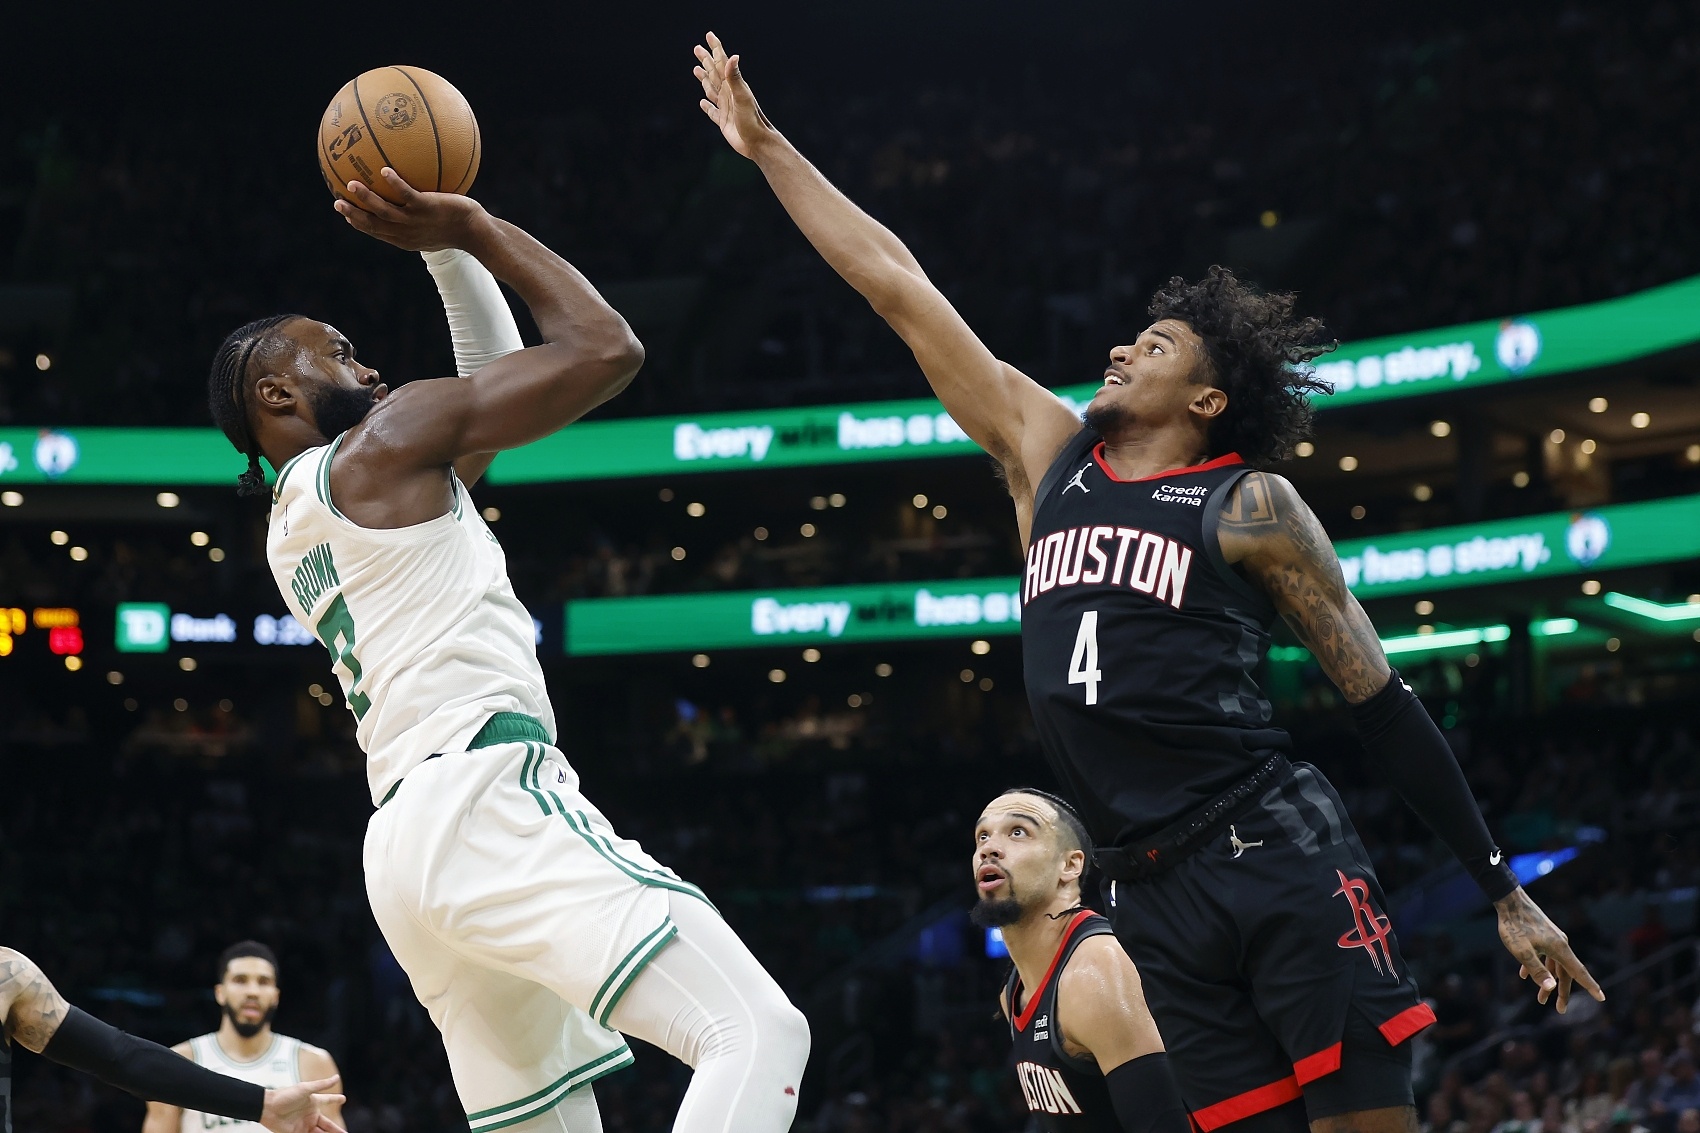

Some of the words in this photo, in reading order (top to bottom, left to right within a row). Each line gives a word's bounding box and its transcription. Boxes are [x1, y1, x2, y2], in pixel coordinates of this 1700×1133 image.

[1383, 341, 1481, 385] story.
[673, 422, 774, 461] Every
[780, 419, 836, 446] win
[837, 411, 906, 450] has
[907, 413, 935, 446] a
[1151, 489, 1202, 507] karma
[1160, 484, 1208, 496] credit
[291, 542, 341, 617] BROWN
[1023, 525, 1193, 611] HOUSTON
[1361, 545, 1426, 585] has
[1427, 544, 1454, 578] a
[1453, 532, 1551, 574] story.
[120, 609, 165, 645] TD
[171, 613, 236, 643] Bank
[751, 597, 850, 637] Every
[857, 595, 914, 622] win
[914, 589, 982, 627] has
[1068, 610, 1102, 706] 4
